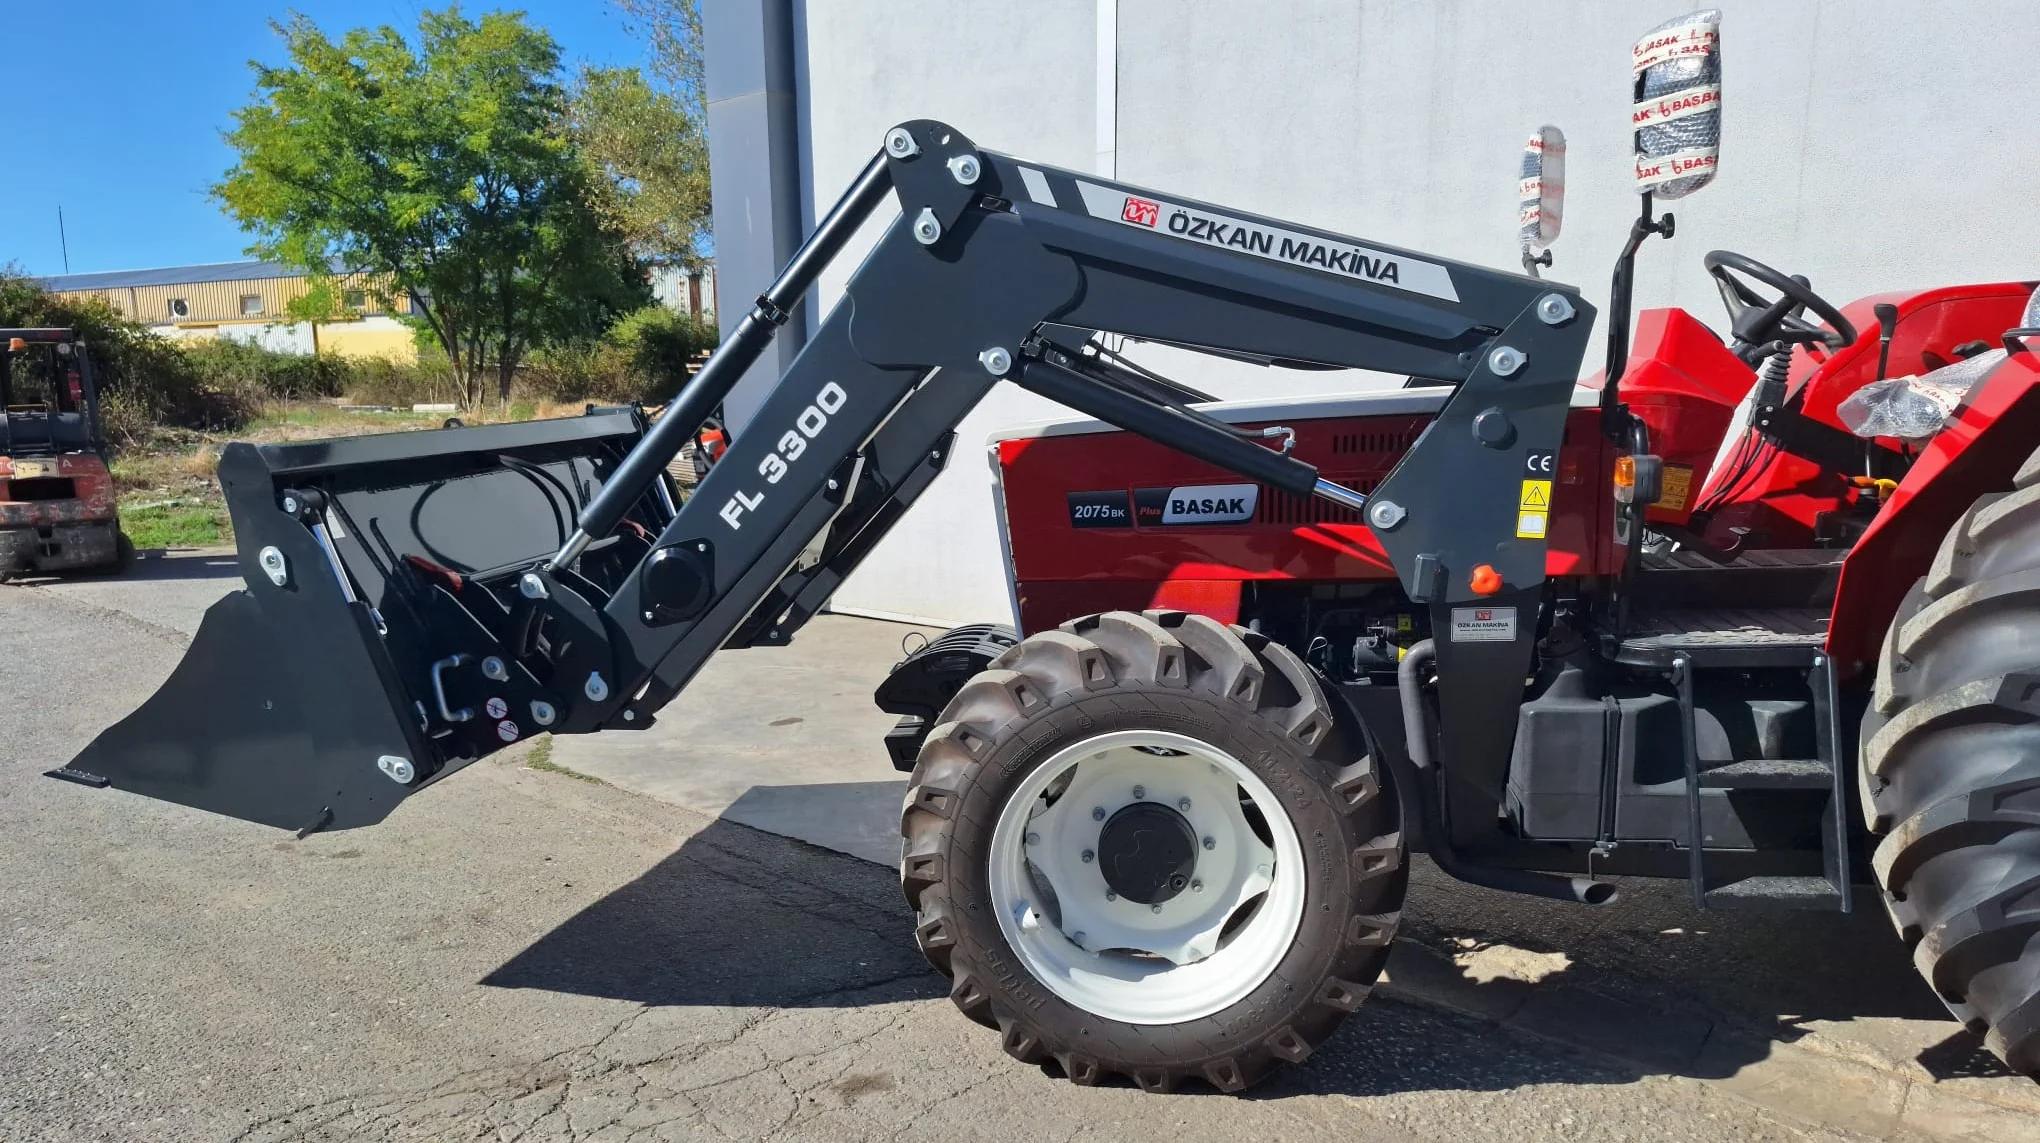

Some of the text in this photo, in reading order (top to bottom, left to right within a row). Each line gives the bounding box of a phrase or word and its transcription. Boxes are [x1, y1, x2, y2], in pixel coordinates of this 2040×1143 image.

[1168, 209, 1274, 254] ÖZKAN
[1279, 237, 1399, 284] MAKİNA
[719, 381, 847, 530] FL 3300
[1074, 504, 1110, 518] 2075
[1111, 509, 1125, 518] BK
[1171, 498, 1245, 515] BASAK
